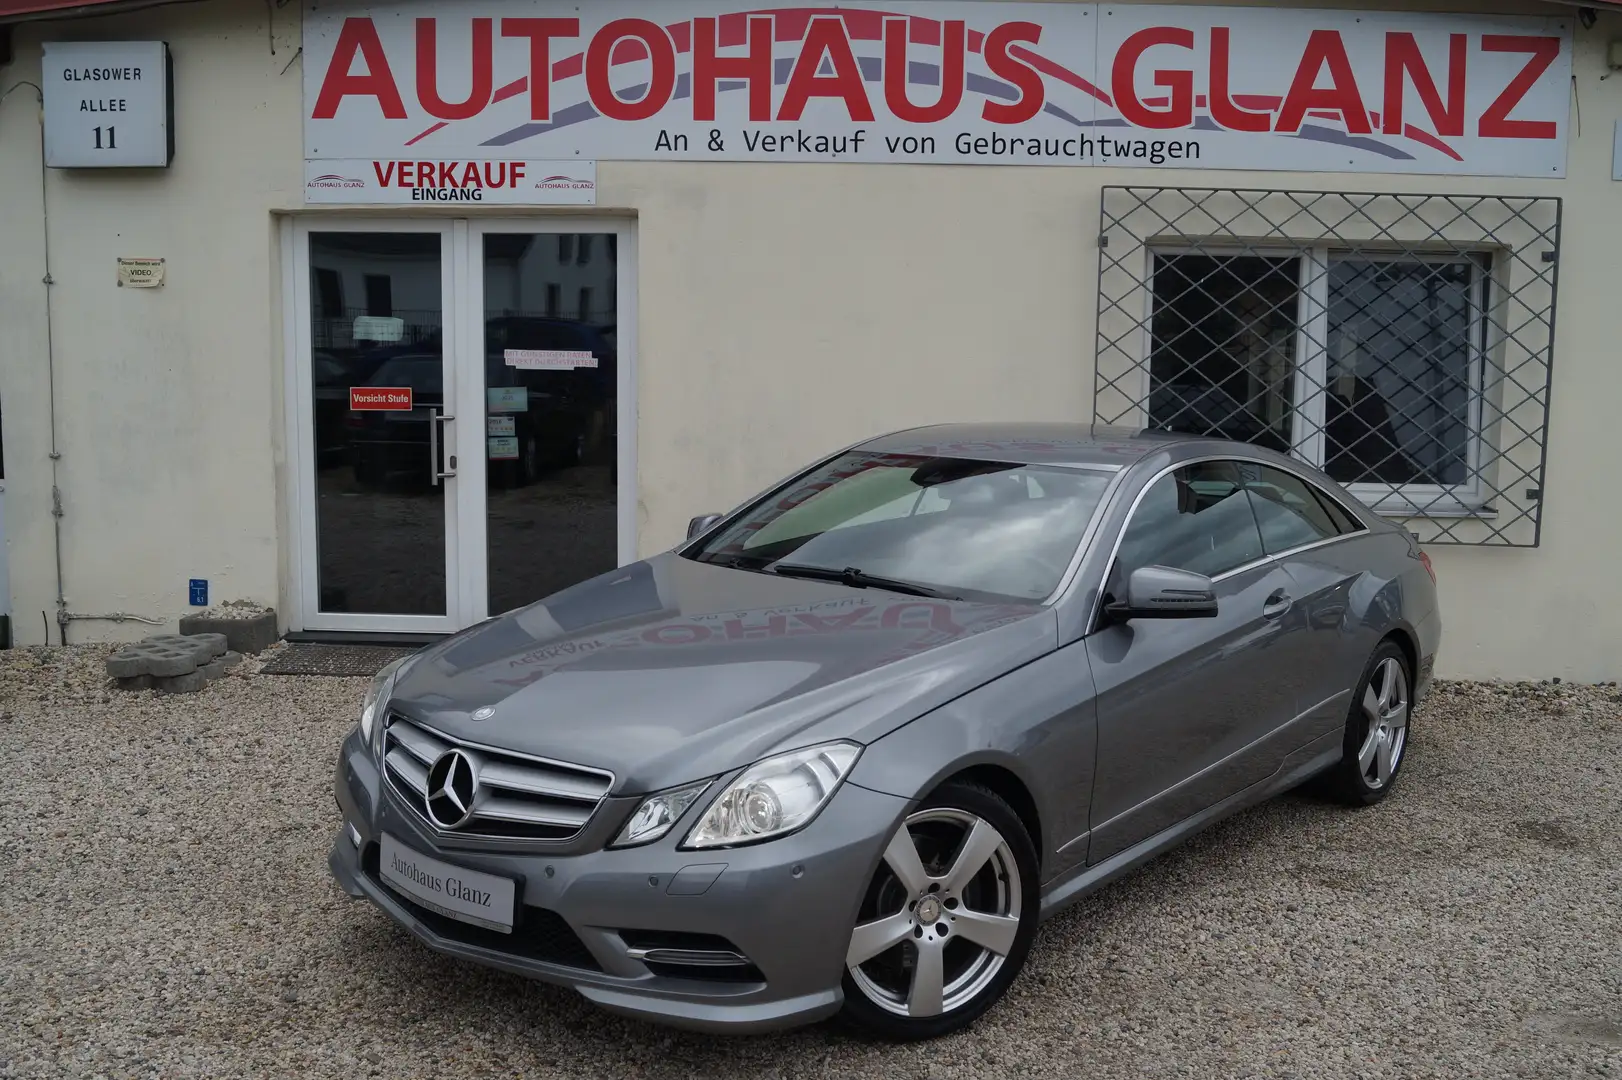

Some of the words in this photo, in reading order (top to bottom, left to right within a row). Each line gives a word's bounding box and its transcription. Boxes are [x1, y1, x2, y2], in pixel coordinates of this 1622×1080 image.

[63, 67, 142, 82] GLASOWER
[311, 17, 1045, 124] AUTOHAUS
[1111, 26, 1561, 139] GLANZ
[80, 99, 127, 112] ALLEE
[92, 126, 118, 149] 11
[654, 129, 688, 151] An
[707, 129, 725, 152] &
[743, 129, 866, 153] Verkauf
[885, 135, 936, 154] von
[955, 132, 1200, 164] Gebrauchtwagen
[373, 161, 525, 189] VERKAUF
[412, 188, 482, 201] EINGANG
[505, 350, 518, 358] MIT
[352, 393, 386, 403] Vorsicht
[387, 393, 409, 403] Stufe
[391, 852, 442, 893] Autohaus
[445, 877, 492, 908] Glanz
